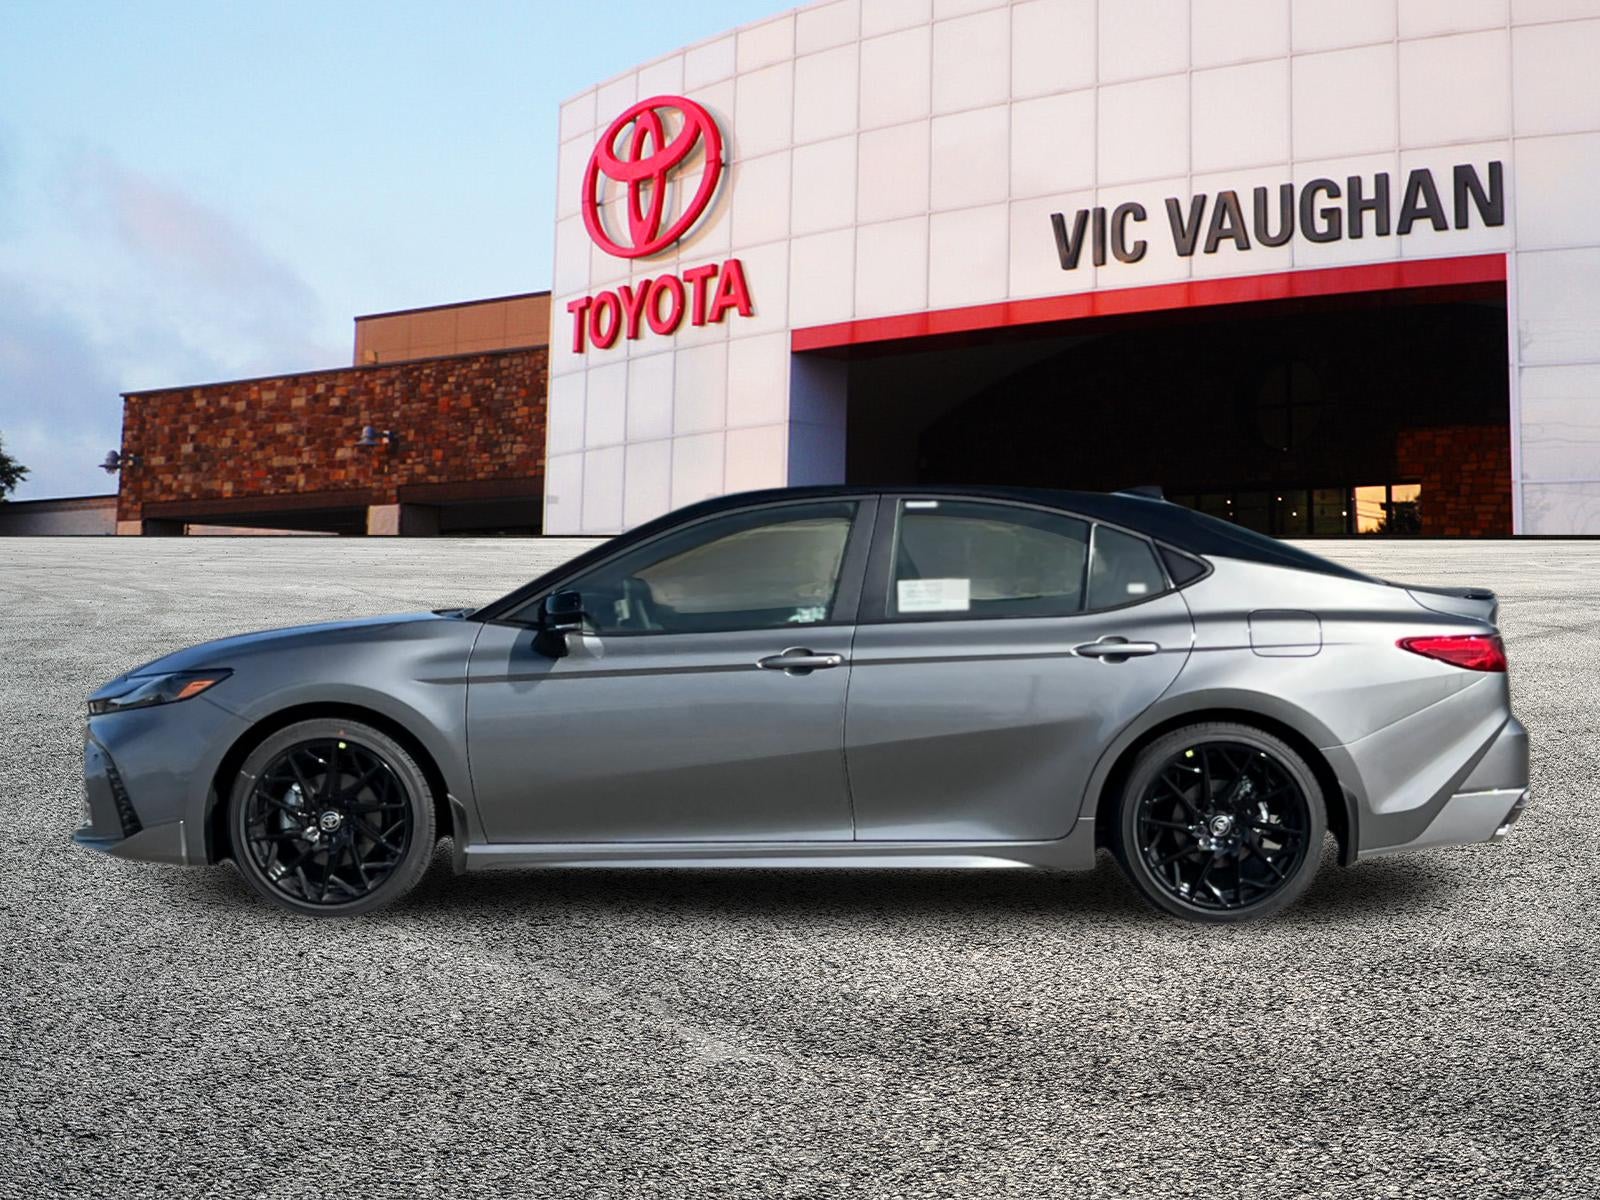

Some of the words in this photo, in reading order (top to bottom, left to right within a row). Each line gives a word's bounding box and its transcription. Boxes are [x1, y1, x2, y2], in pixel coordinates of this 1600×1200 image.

[1051, 202, 1148, 270] VIC
[1164, 161, 1505, 257] VAUGHAN
[567, 258, 753, 353] TOYOTA
